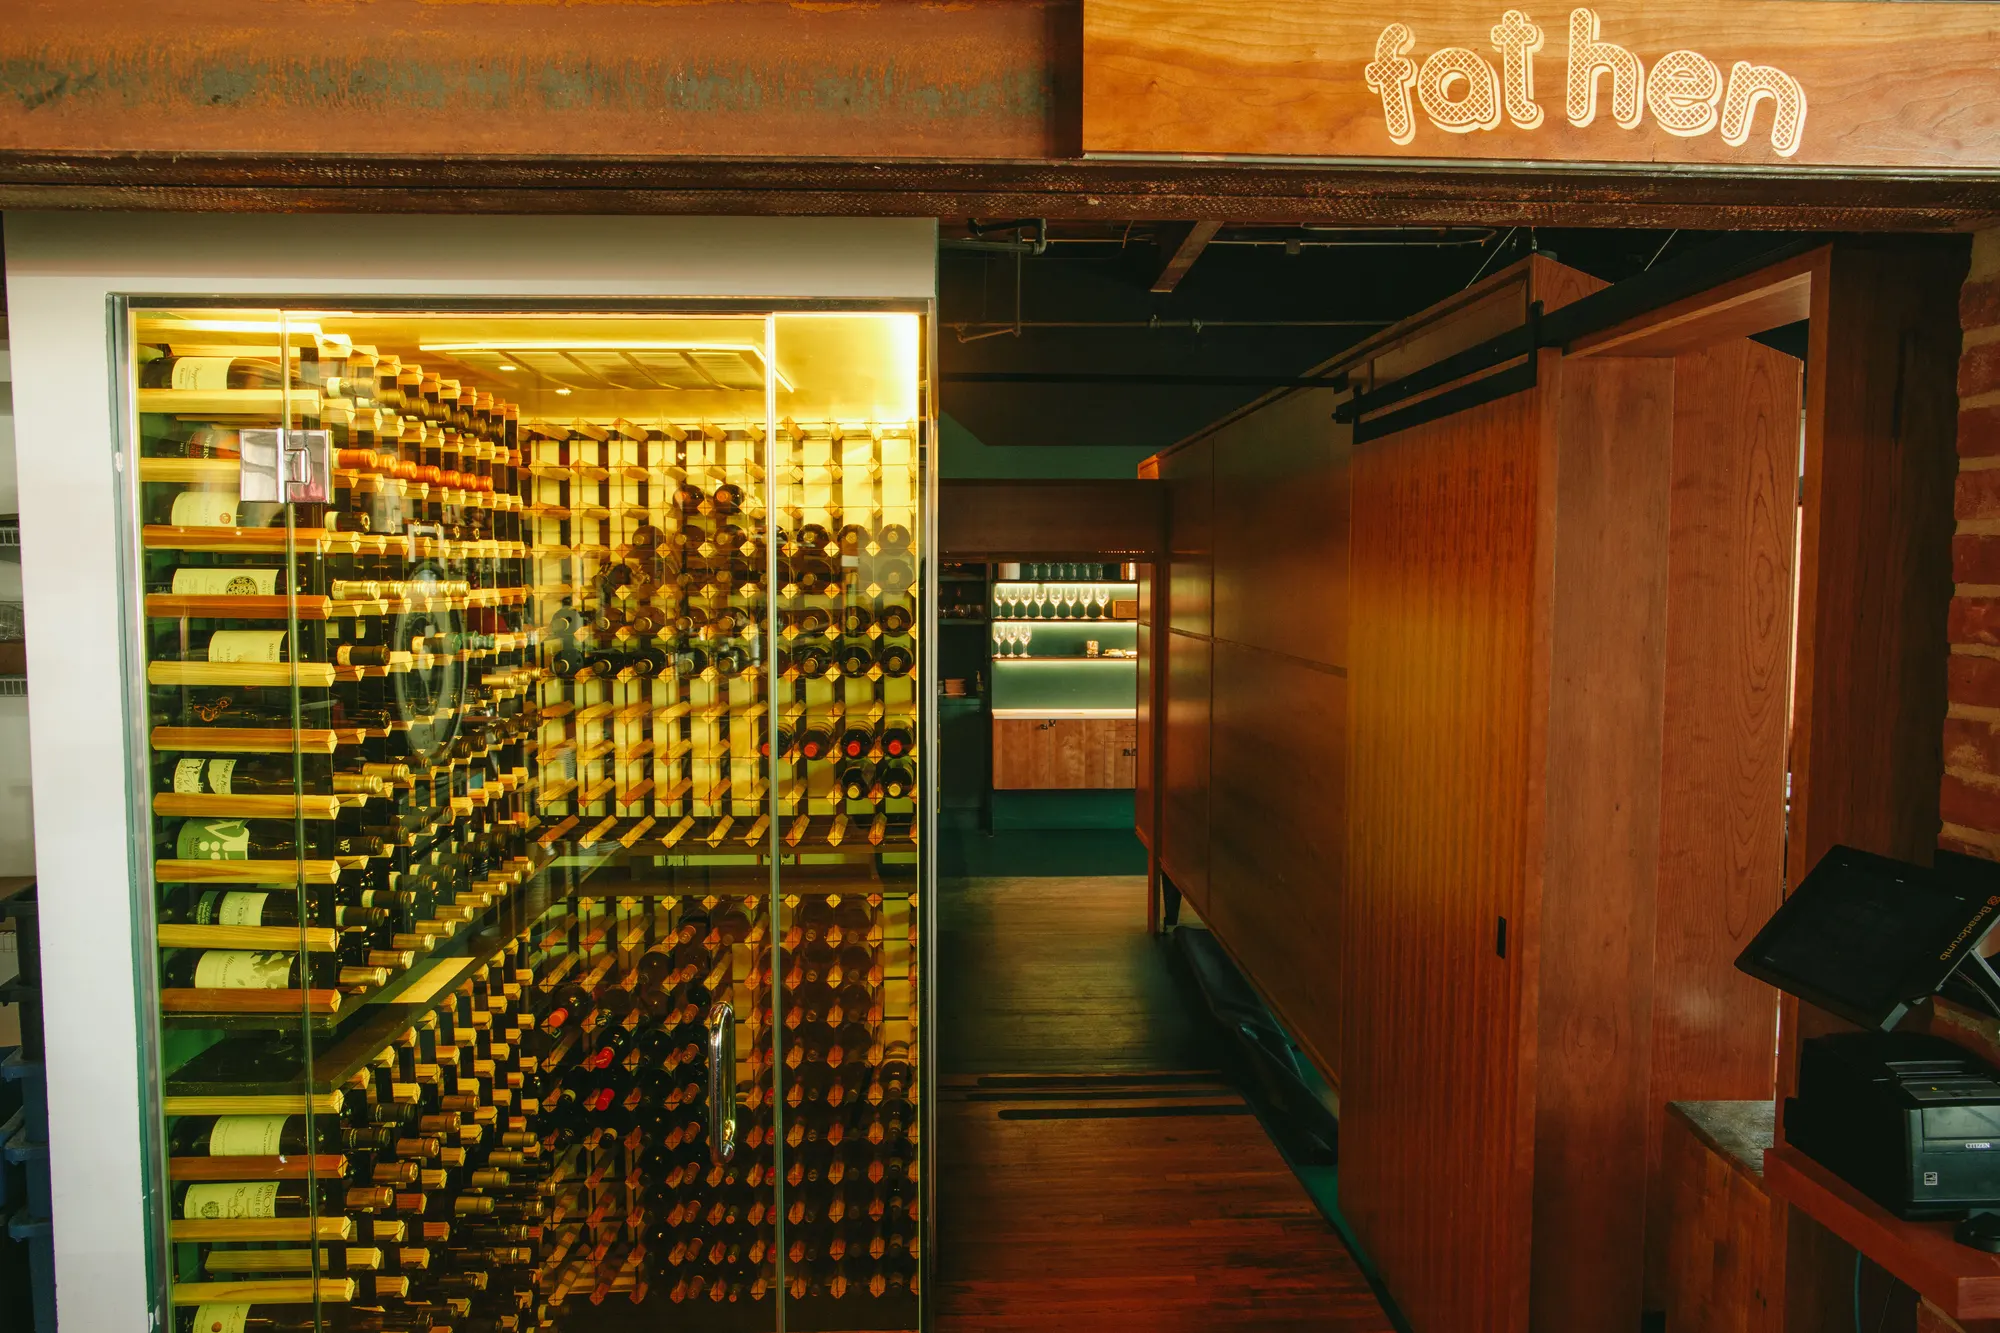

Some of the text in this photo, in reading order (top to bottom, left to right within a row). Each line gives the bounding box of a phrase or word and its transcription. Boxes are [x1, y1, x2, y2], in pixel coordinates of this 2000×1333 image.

[1364, 7, 1807, 157] fat hen
[1940, 906, 1992, 960] Breadcrumb
